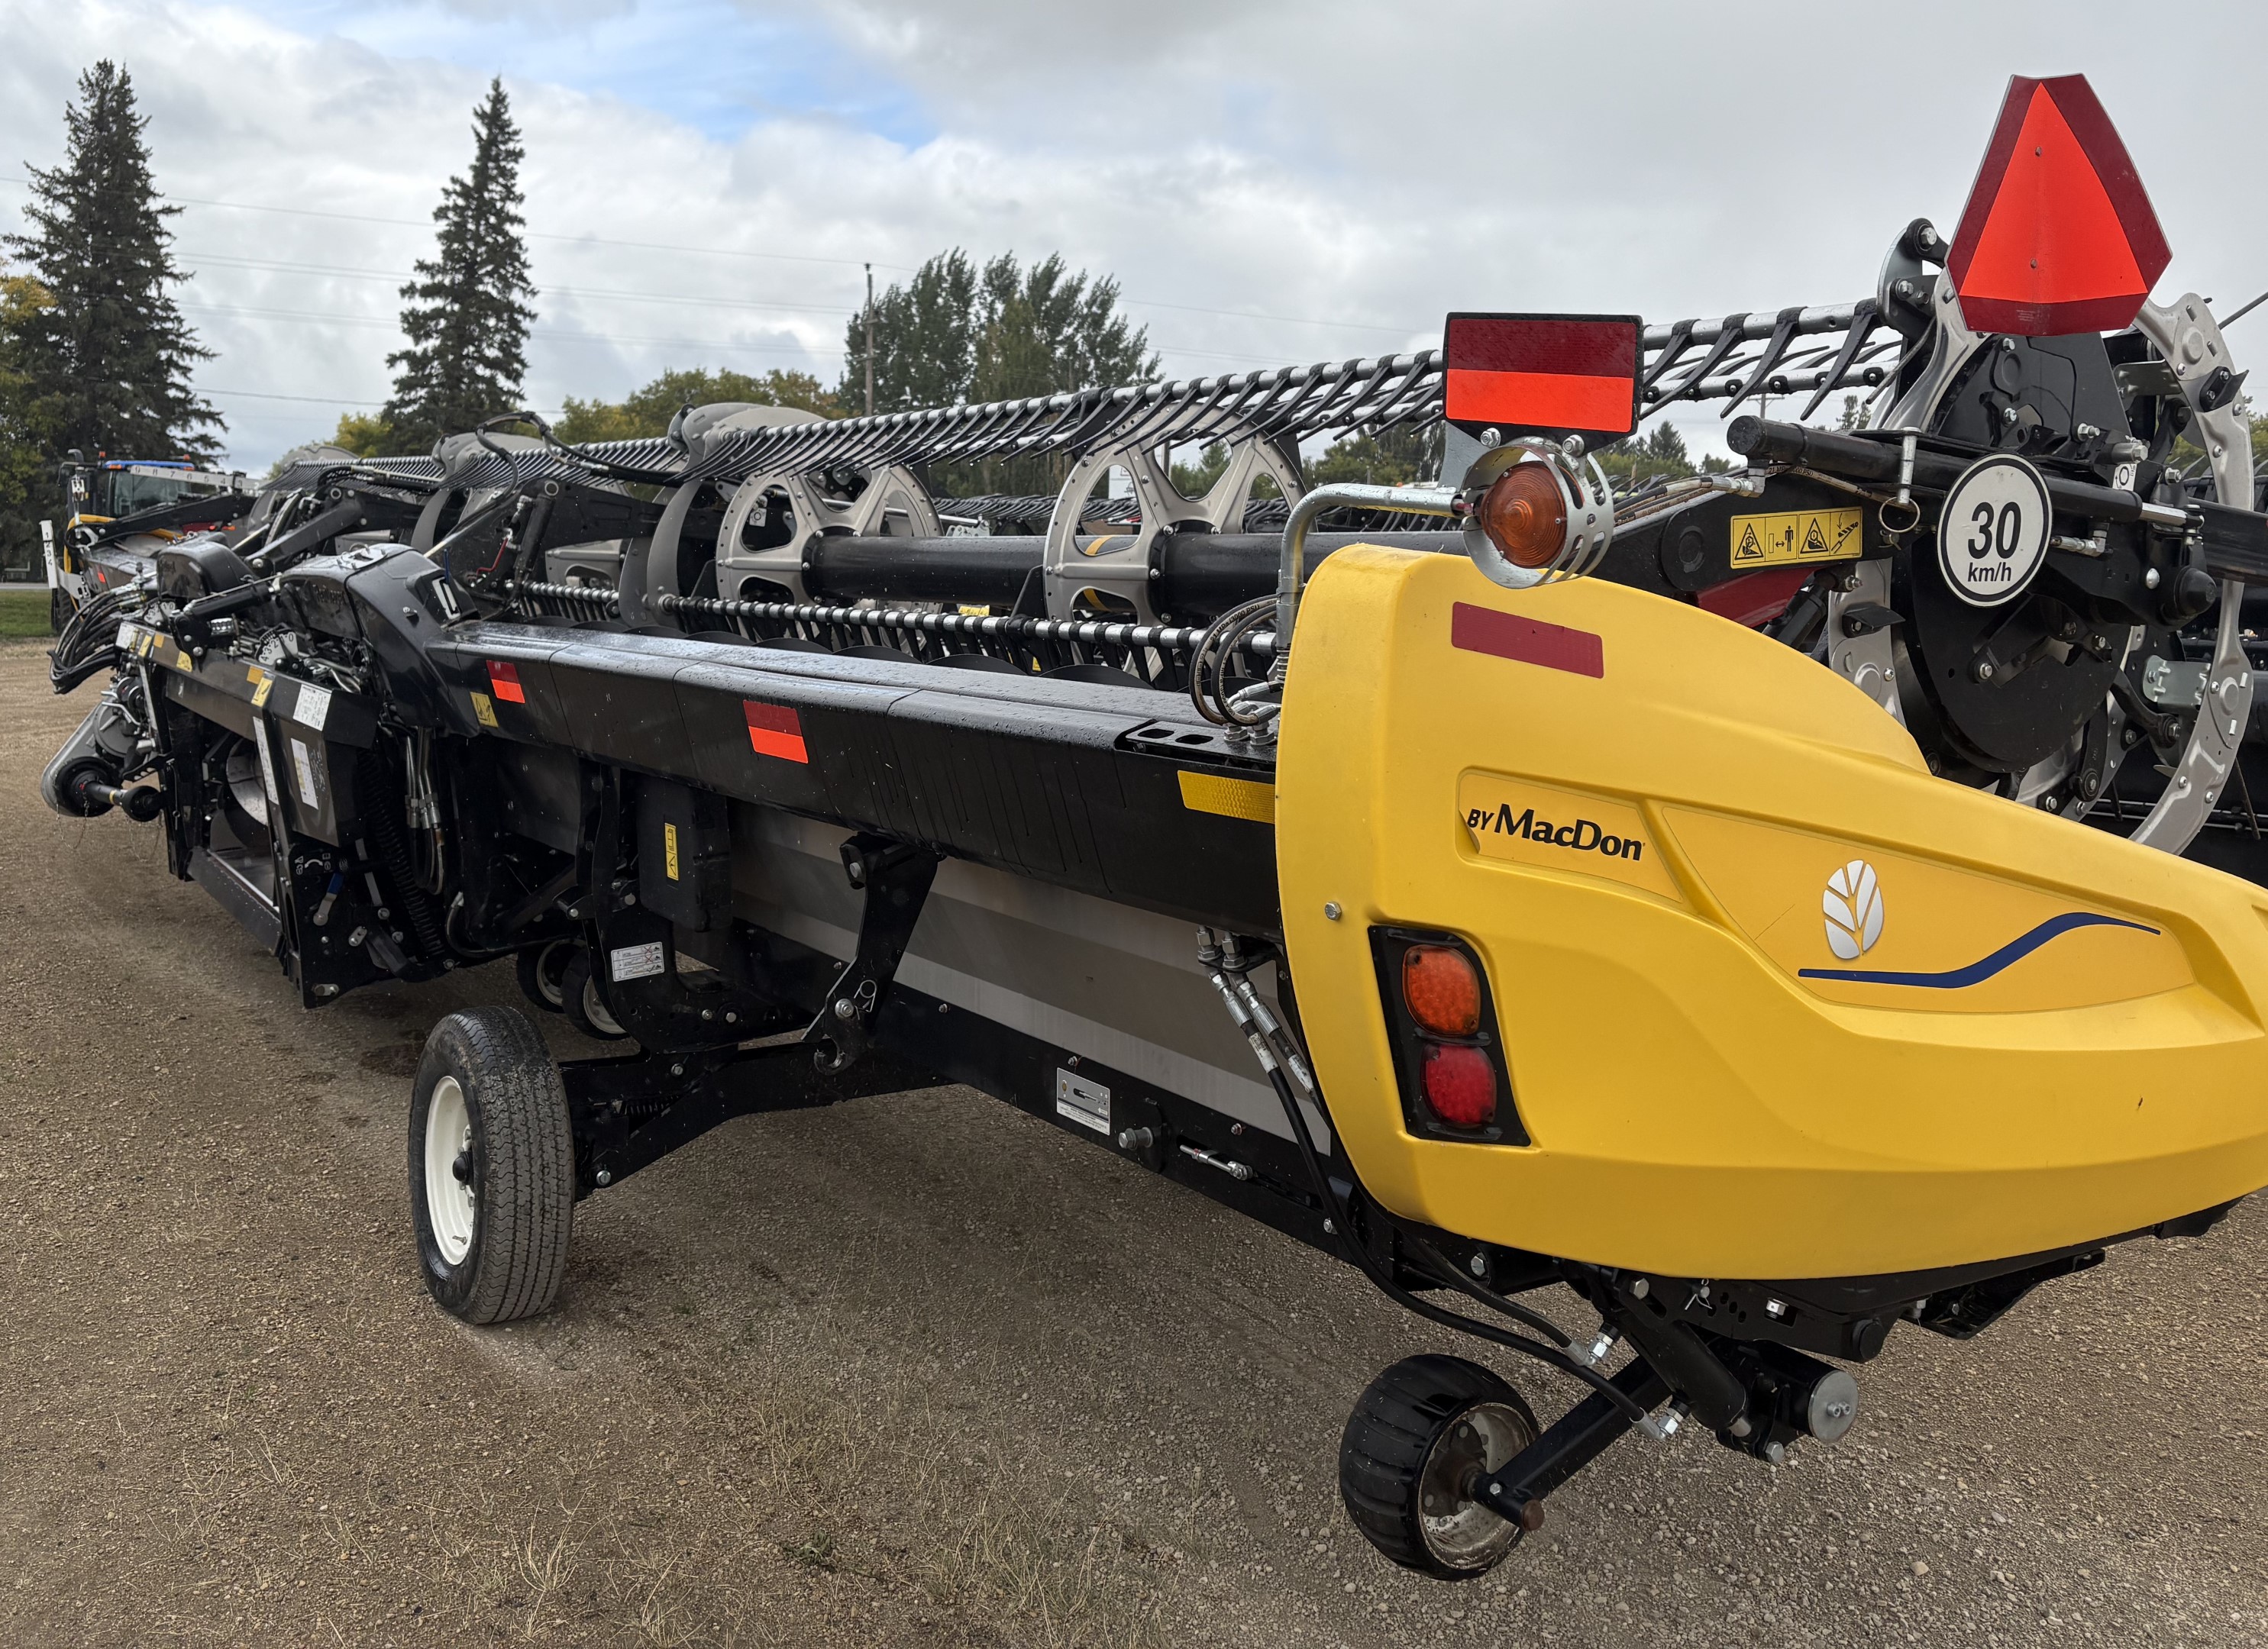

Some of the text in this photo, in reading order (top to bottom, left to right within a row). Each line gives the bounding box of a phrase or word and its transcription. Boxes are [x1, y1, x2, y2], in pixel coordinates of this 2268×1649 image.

[1967, 501, 2022, 560] 30
[1967, 561, 2012, 582] km/h
[271, 640, 279, 649] 2
[288, 633, 294, 643] 0
[1466, 803, 1643, 861] BY MacDon
